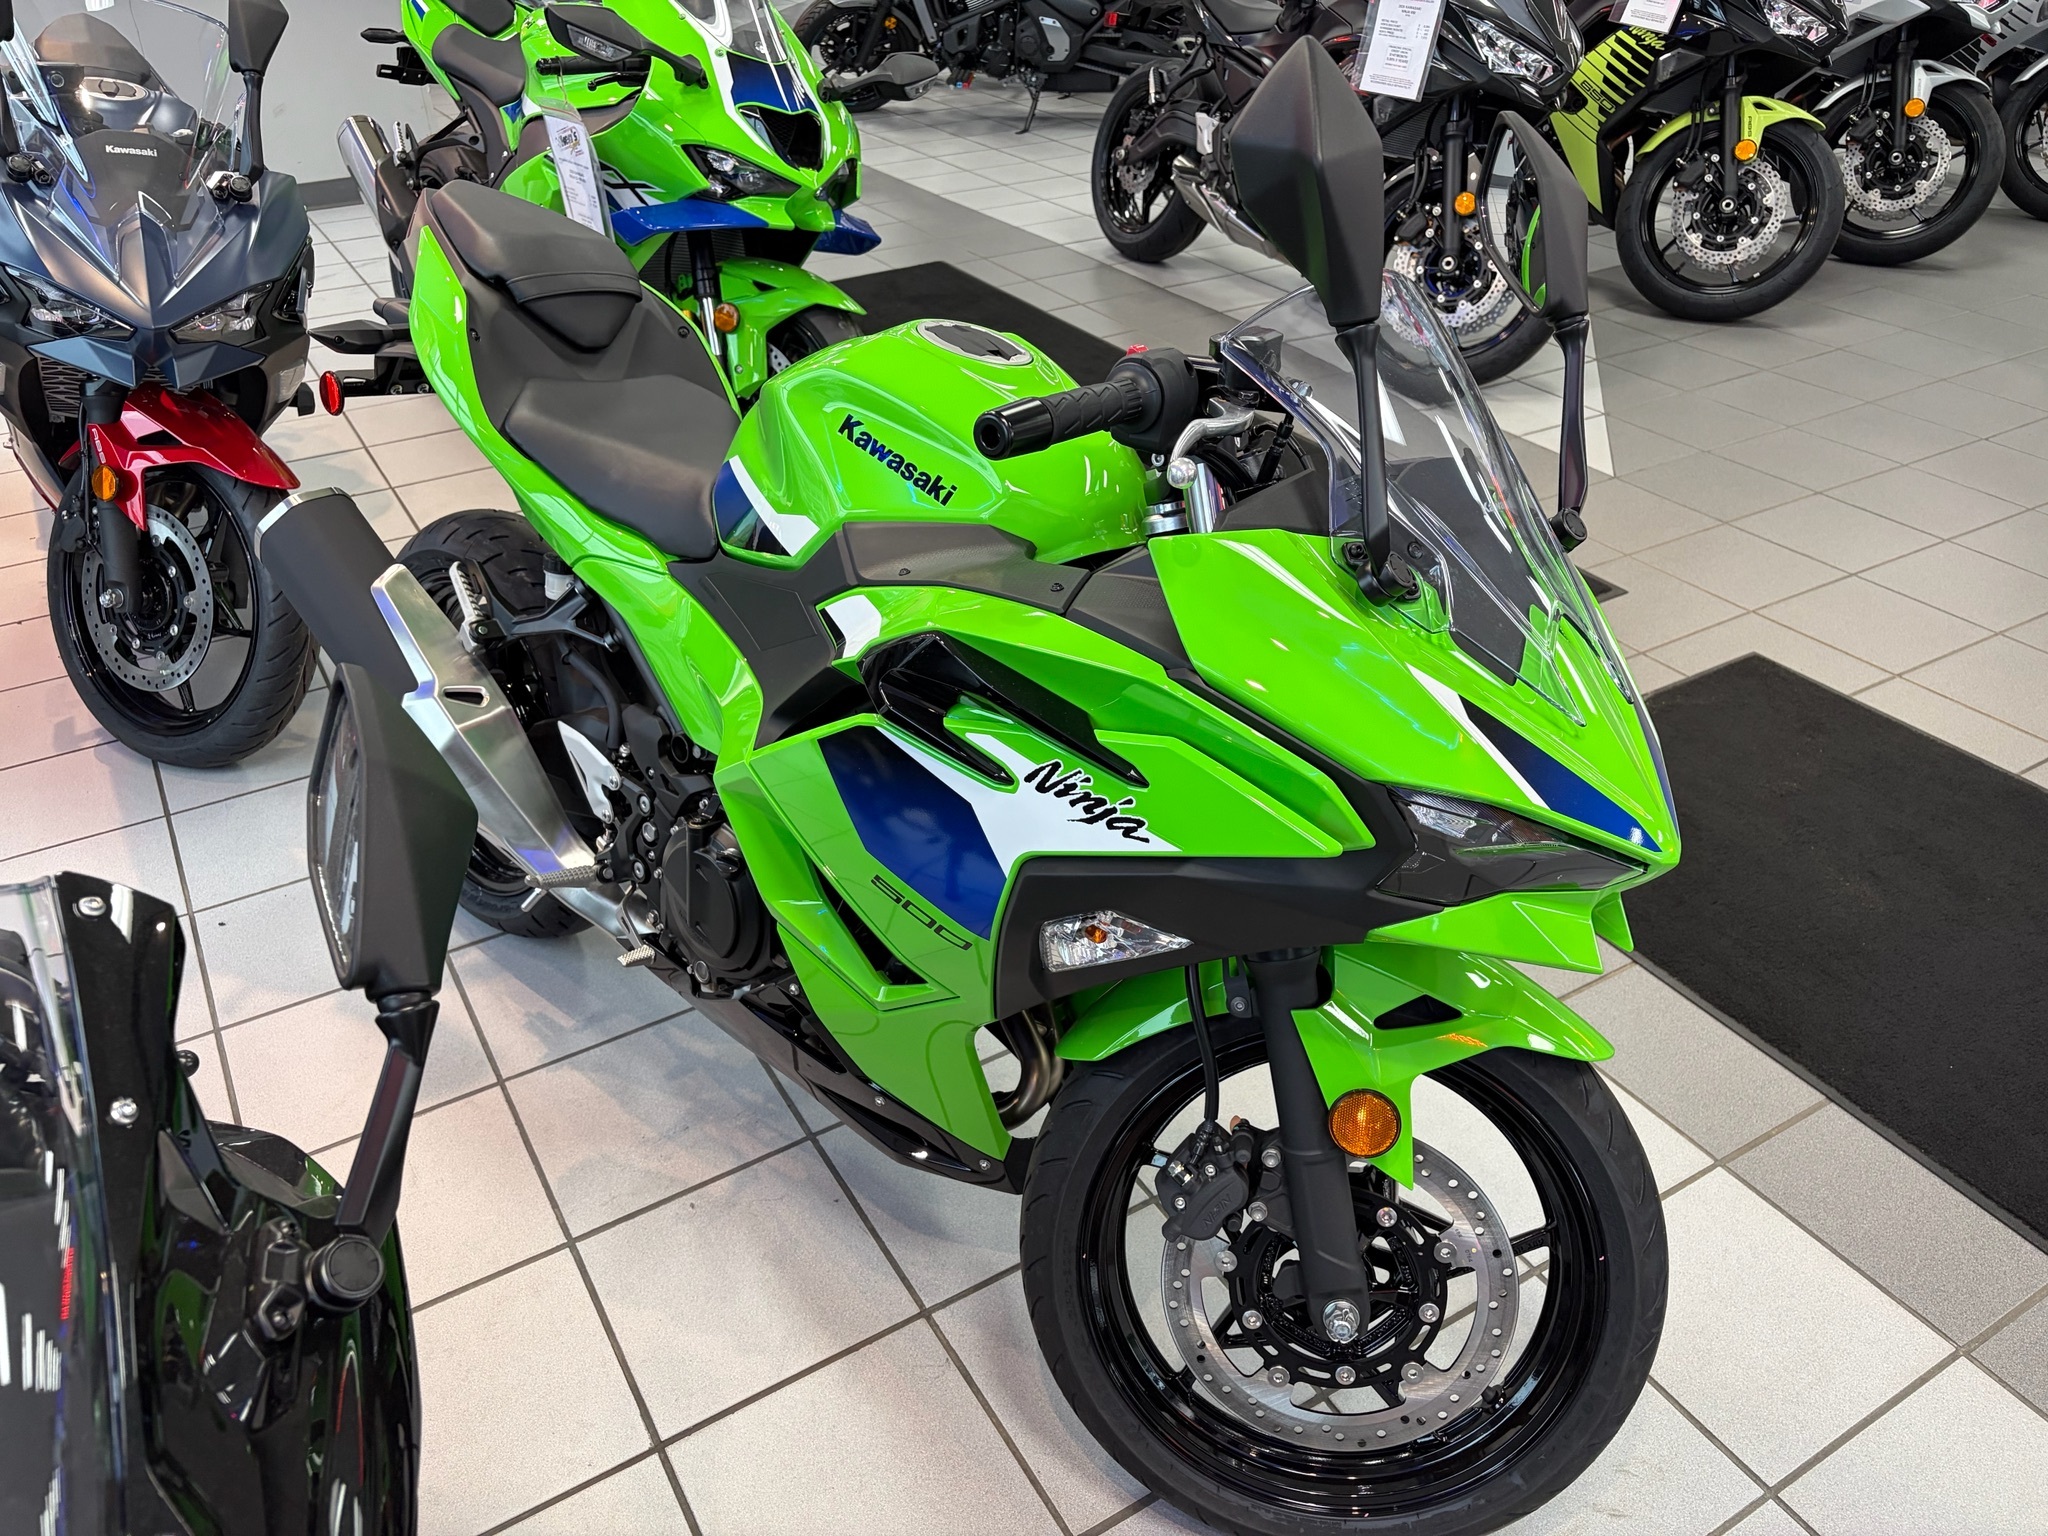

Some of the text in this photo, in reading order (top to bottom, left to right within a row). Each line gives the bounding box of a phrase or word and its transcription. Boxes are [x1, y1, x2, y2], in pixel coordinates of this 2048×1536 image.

[1579, 79, 1617, 114] 650
[105, 144, 158, 157] Kawasaki
[837, 413, 958, 507] Kawasaki
[1023, 760, 1150, 844] Ninja
[870, 874, 973, 951] 500
